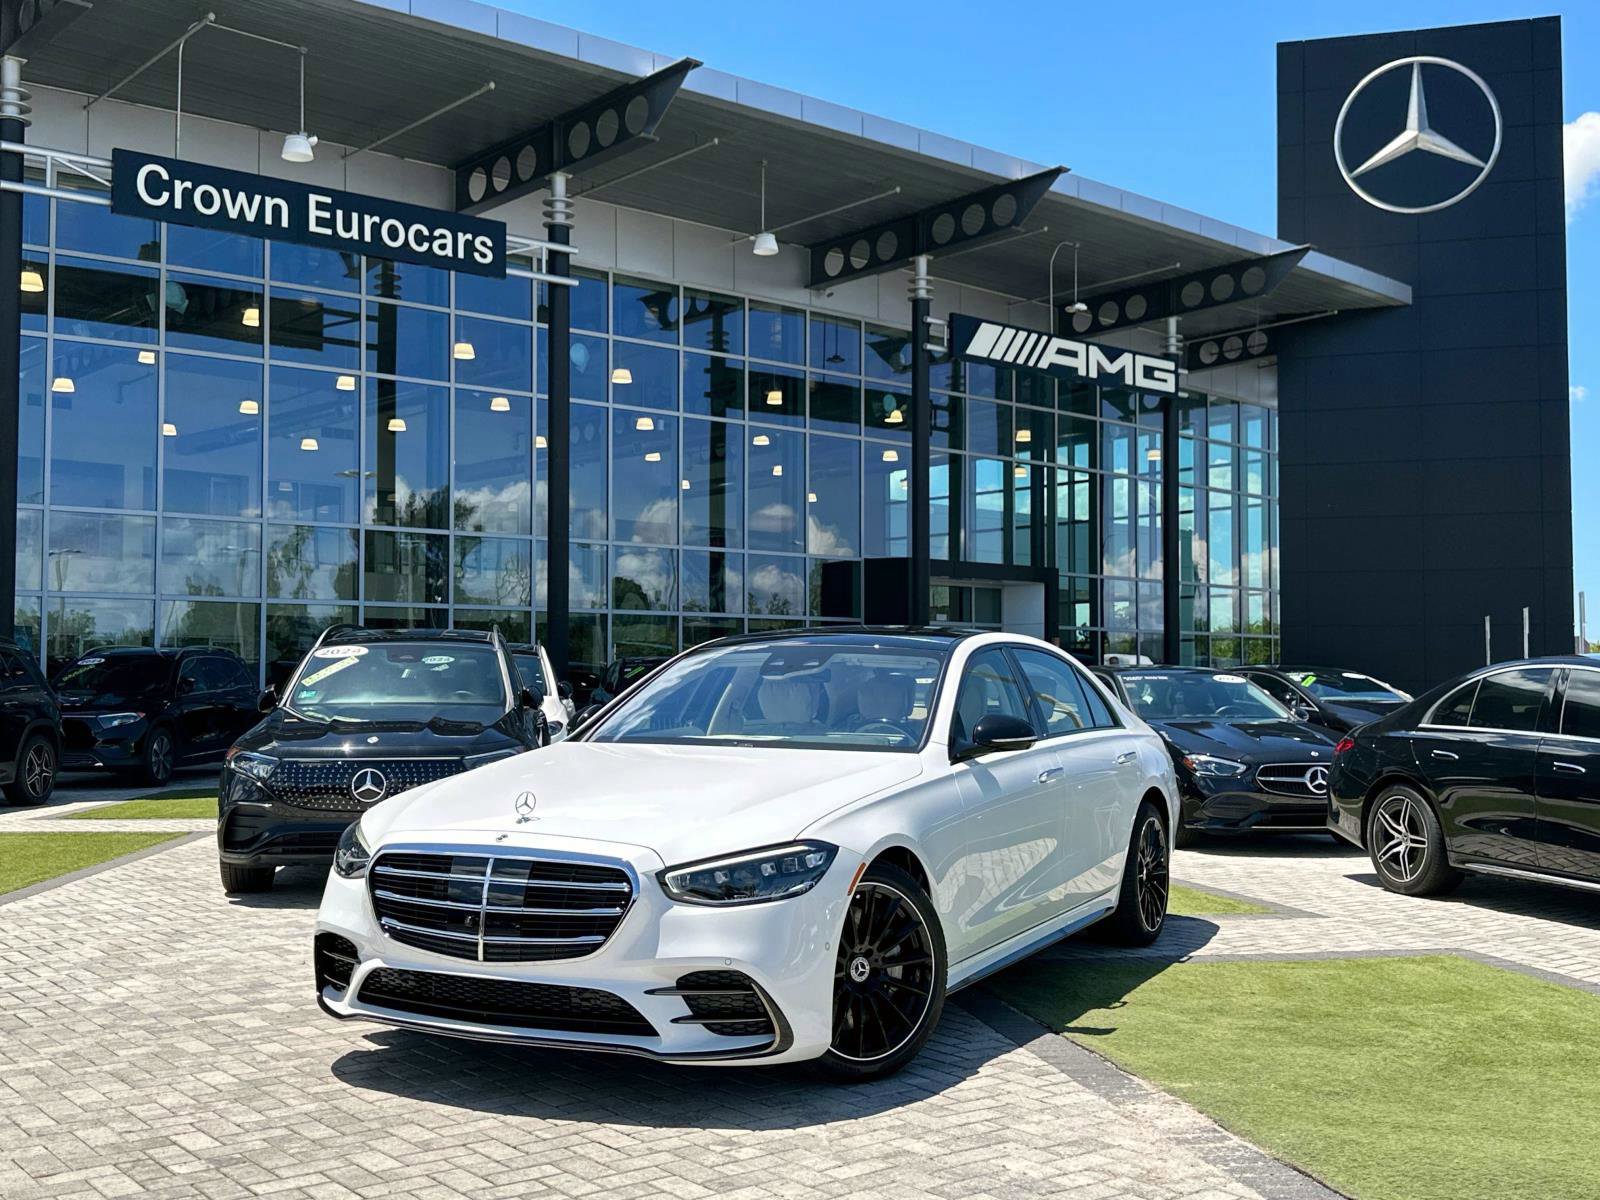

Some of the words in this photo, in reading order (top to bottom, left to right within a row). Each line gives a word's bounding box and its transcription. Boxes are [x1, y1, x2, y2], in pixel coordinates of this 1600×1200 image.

[136, 163, 289, 229] Crown
[308, 194, 494, 265] Eurocars
[1036, 336, 1176, 393] AMG
